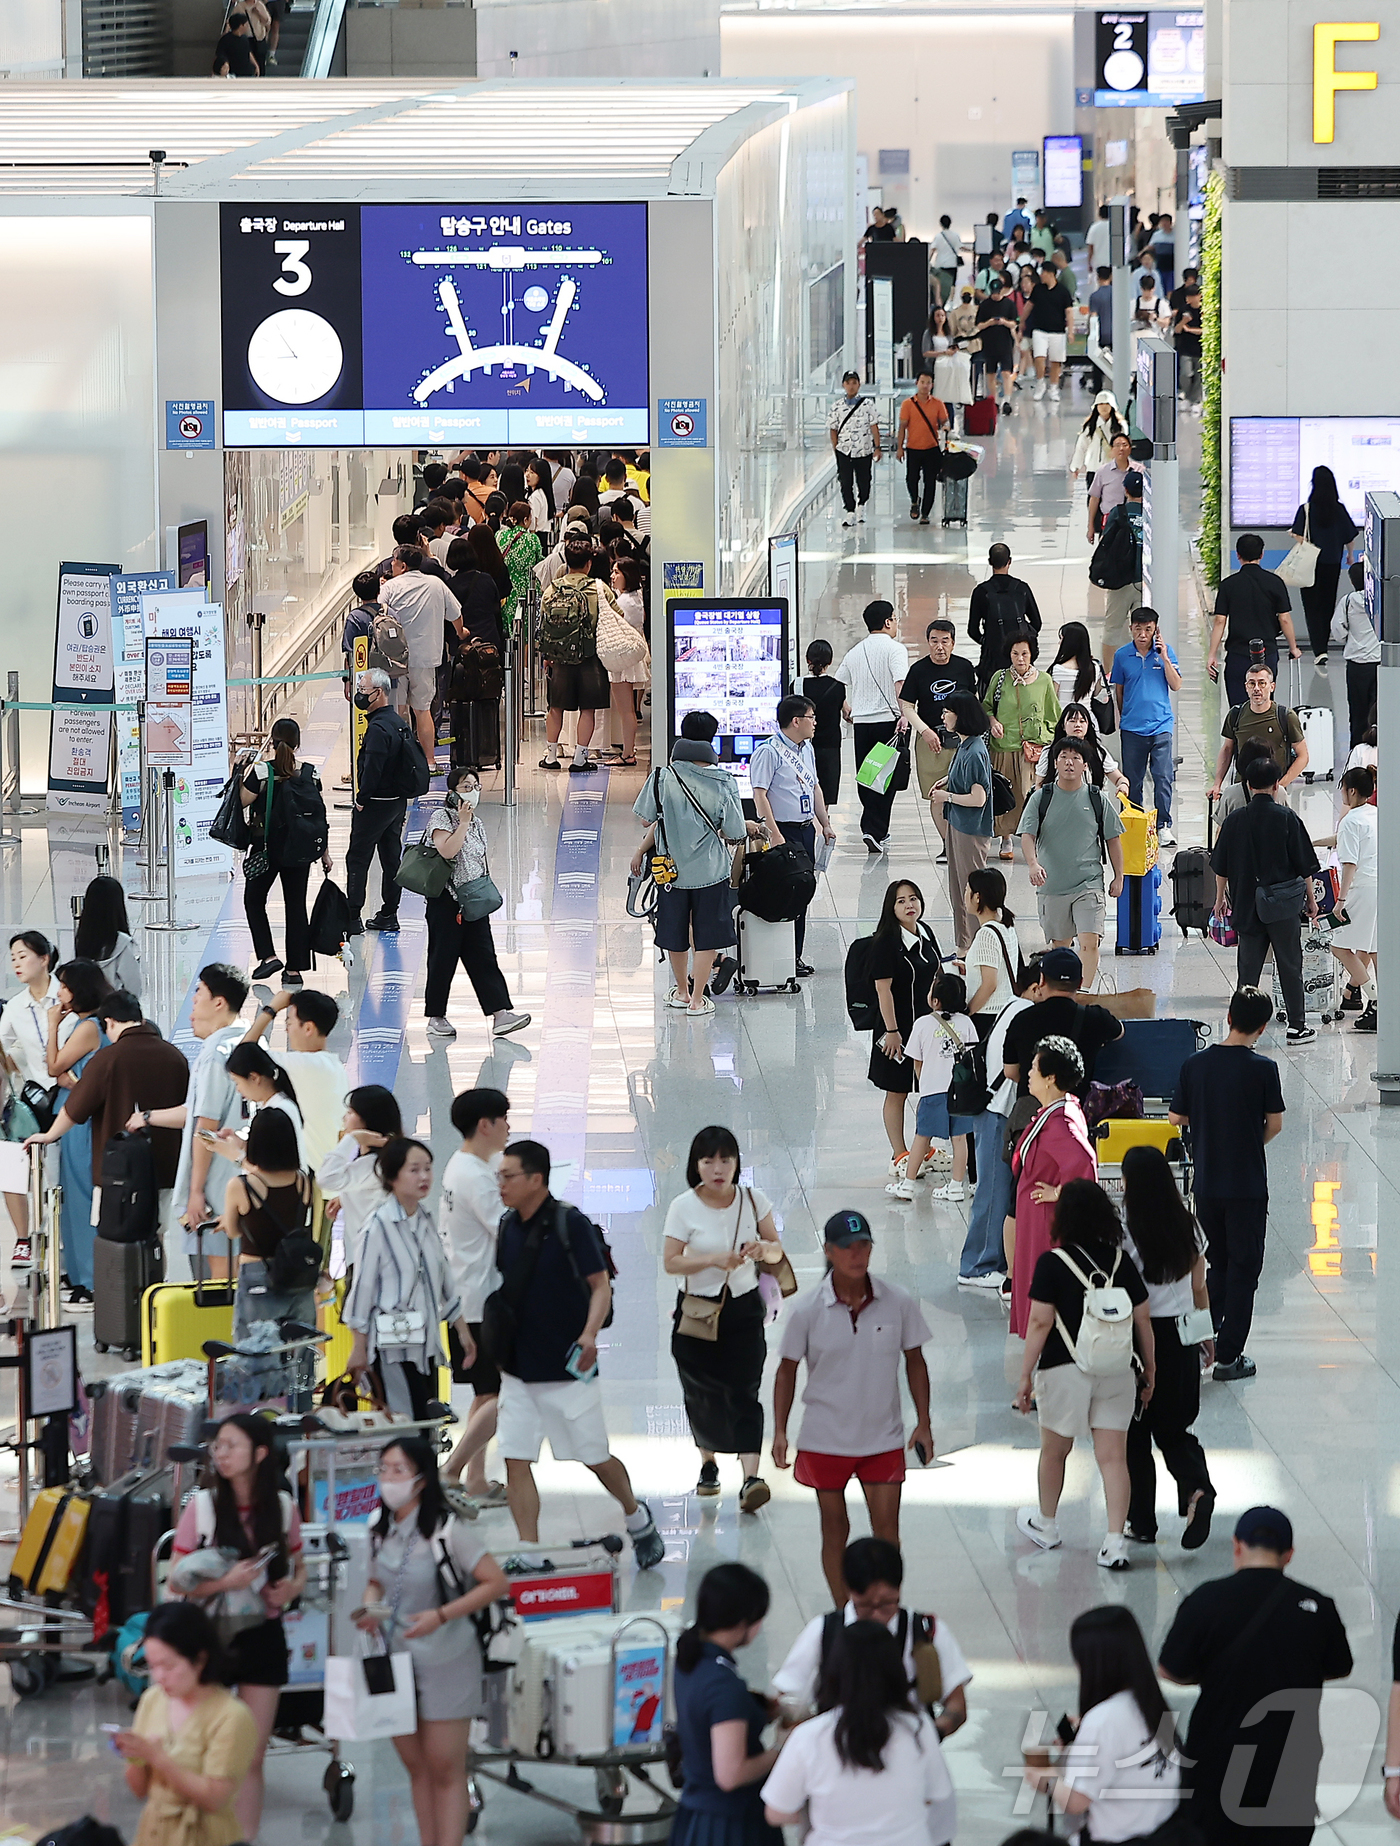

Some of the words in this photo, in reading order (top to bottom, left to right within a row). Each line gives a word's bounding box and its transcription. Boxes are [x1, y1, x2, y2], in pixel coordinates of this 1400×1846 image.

[1114, 24, 1133, 50] 2
[1313, 22, 1380, 143] F
[240, 217, 277, 233] 출국장
[283, 220, 327, 233] Departure
[328, 220, 345, 231] Hall
[440, 216, 487, 236] 탑승구
[489, 216, 521, 235] 안내
[526, 219, 572, 235] Gates
[272, 240, 313, 297] 3
[290, 418, 338, 430] Passport
[434, 416, 481, 428] Passport
[577, 416, 624, 428] Passport
[63, 579, 84, 587] Please
[85, 581, 102, 589] carry
[116, 579, 168, 594] 외국환신고
[76, 590, 104, 598] passport
[67, 597, 94, 607] boarding
[117, 595, 139, 604] CURRENC
[724, 611, 745, 620] 대기열
[746, 611, 760, 619] 상황
[162, 628, 177, 638] 해외
[179, 626, 201, 636] 여행시
[67, 643, 106, 654] 여권/탑승권은
[77, 654, 94, 662] 반드시
[70, 663, 87, 672] 본인이
[89, 665, 101, 673] 소지
[73, 674, 97, 682] 해주세요
[64, 719, 100, 727] passengers
[76, 736, 93, 744] enter.
[71, 747, 91, 756] 환승객
[73, 757, 86, 766] 절대
[67, 766, 93, 776] 진입금지
[848, 1216, 861, 1232] D
